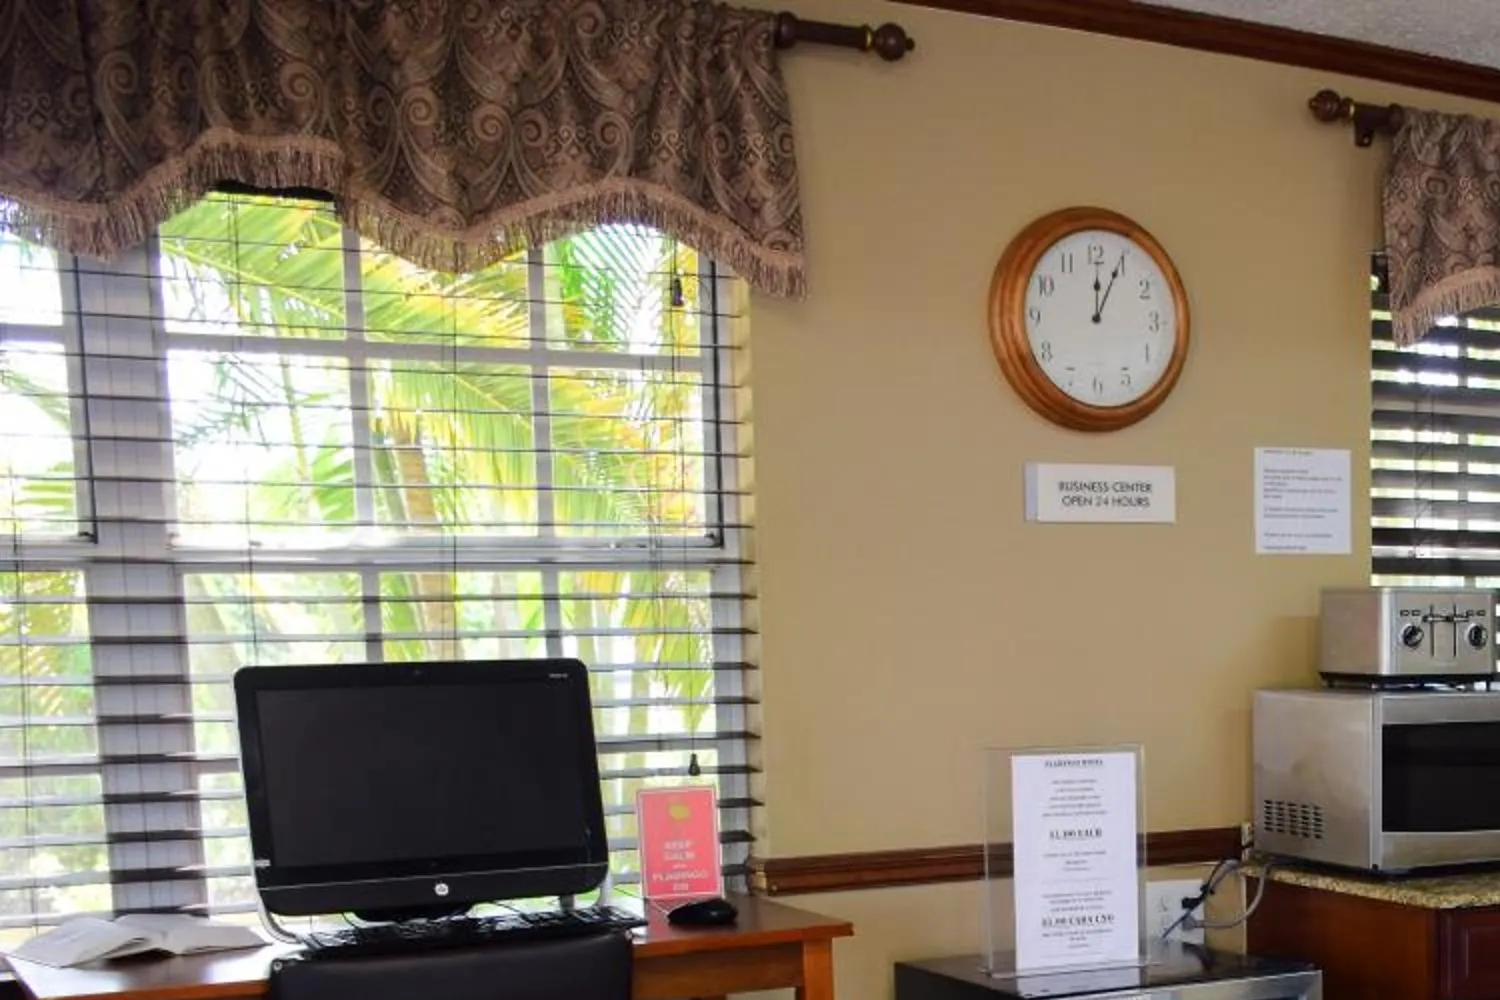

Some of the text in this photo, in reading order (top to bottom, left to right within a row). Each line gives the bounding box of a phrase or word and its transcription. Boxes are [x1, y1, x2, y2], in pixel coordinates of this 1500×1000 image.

[1061, 253, 1073, 273] 11
[1088, 244, 1104, 265] 12
[1039, 275, 1054, 297] 10
[1139, 279, 1151, 300] 2
[1029, 307, 1041, 327] 9
[1149, 312, 1160, 333] 3
[1041, 341, 1053, 362] 8
[1058, 481, 1153, 493] BUSINESS CENTER
[1061, 496, 1151, 508] OPEN 24 HOURS
